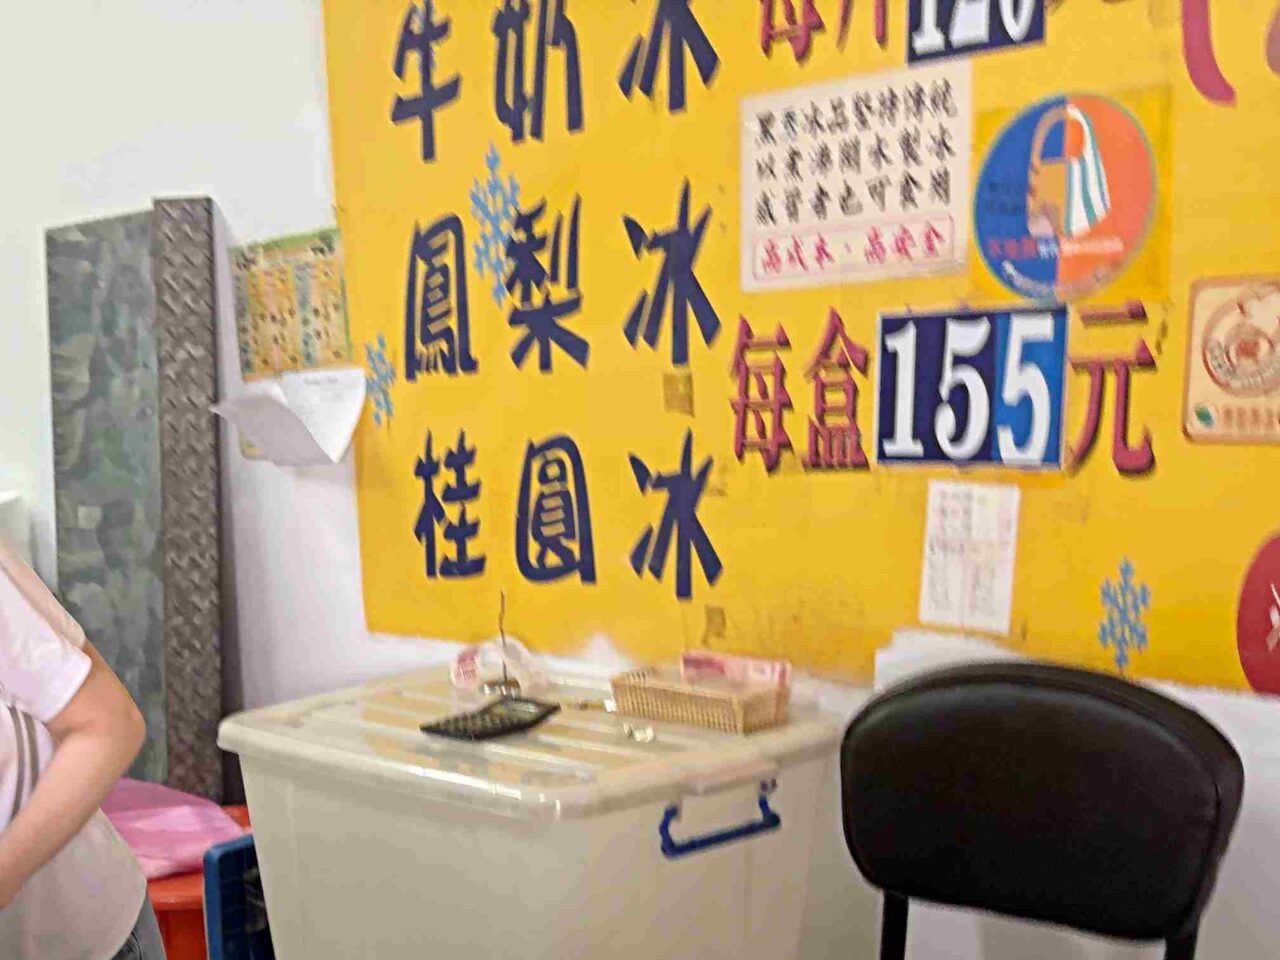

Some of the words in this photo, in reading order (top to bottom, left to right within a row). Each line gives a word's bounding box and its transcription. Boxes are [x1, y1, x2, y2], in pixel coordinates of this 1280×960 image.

[404, 178, 722, 382] 鳳梨冰
[413, 428, 723, 600] 桂圓冰
